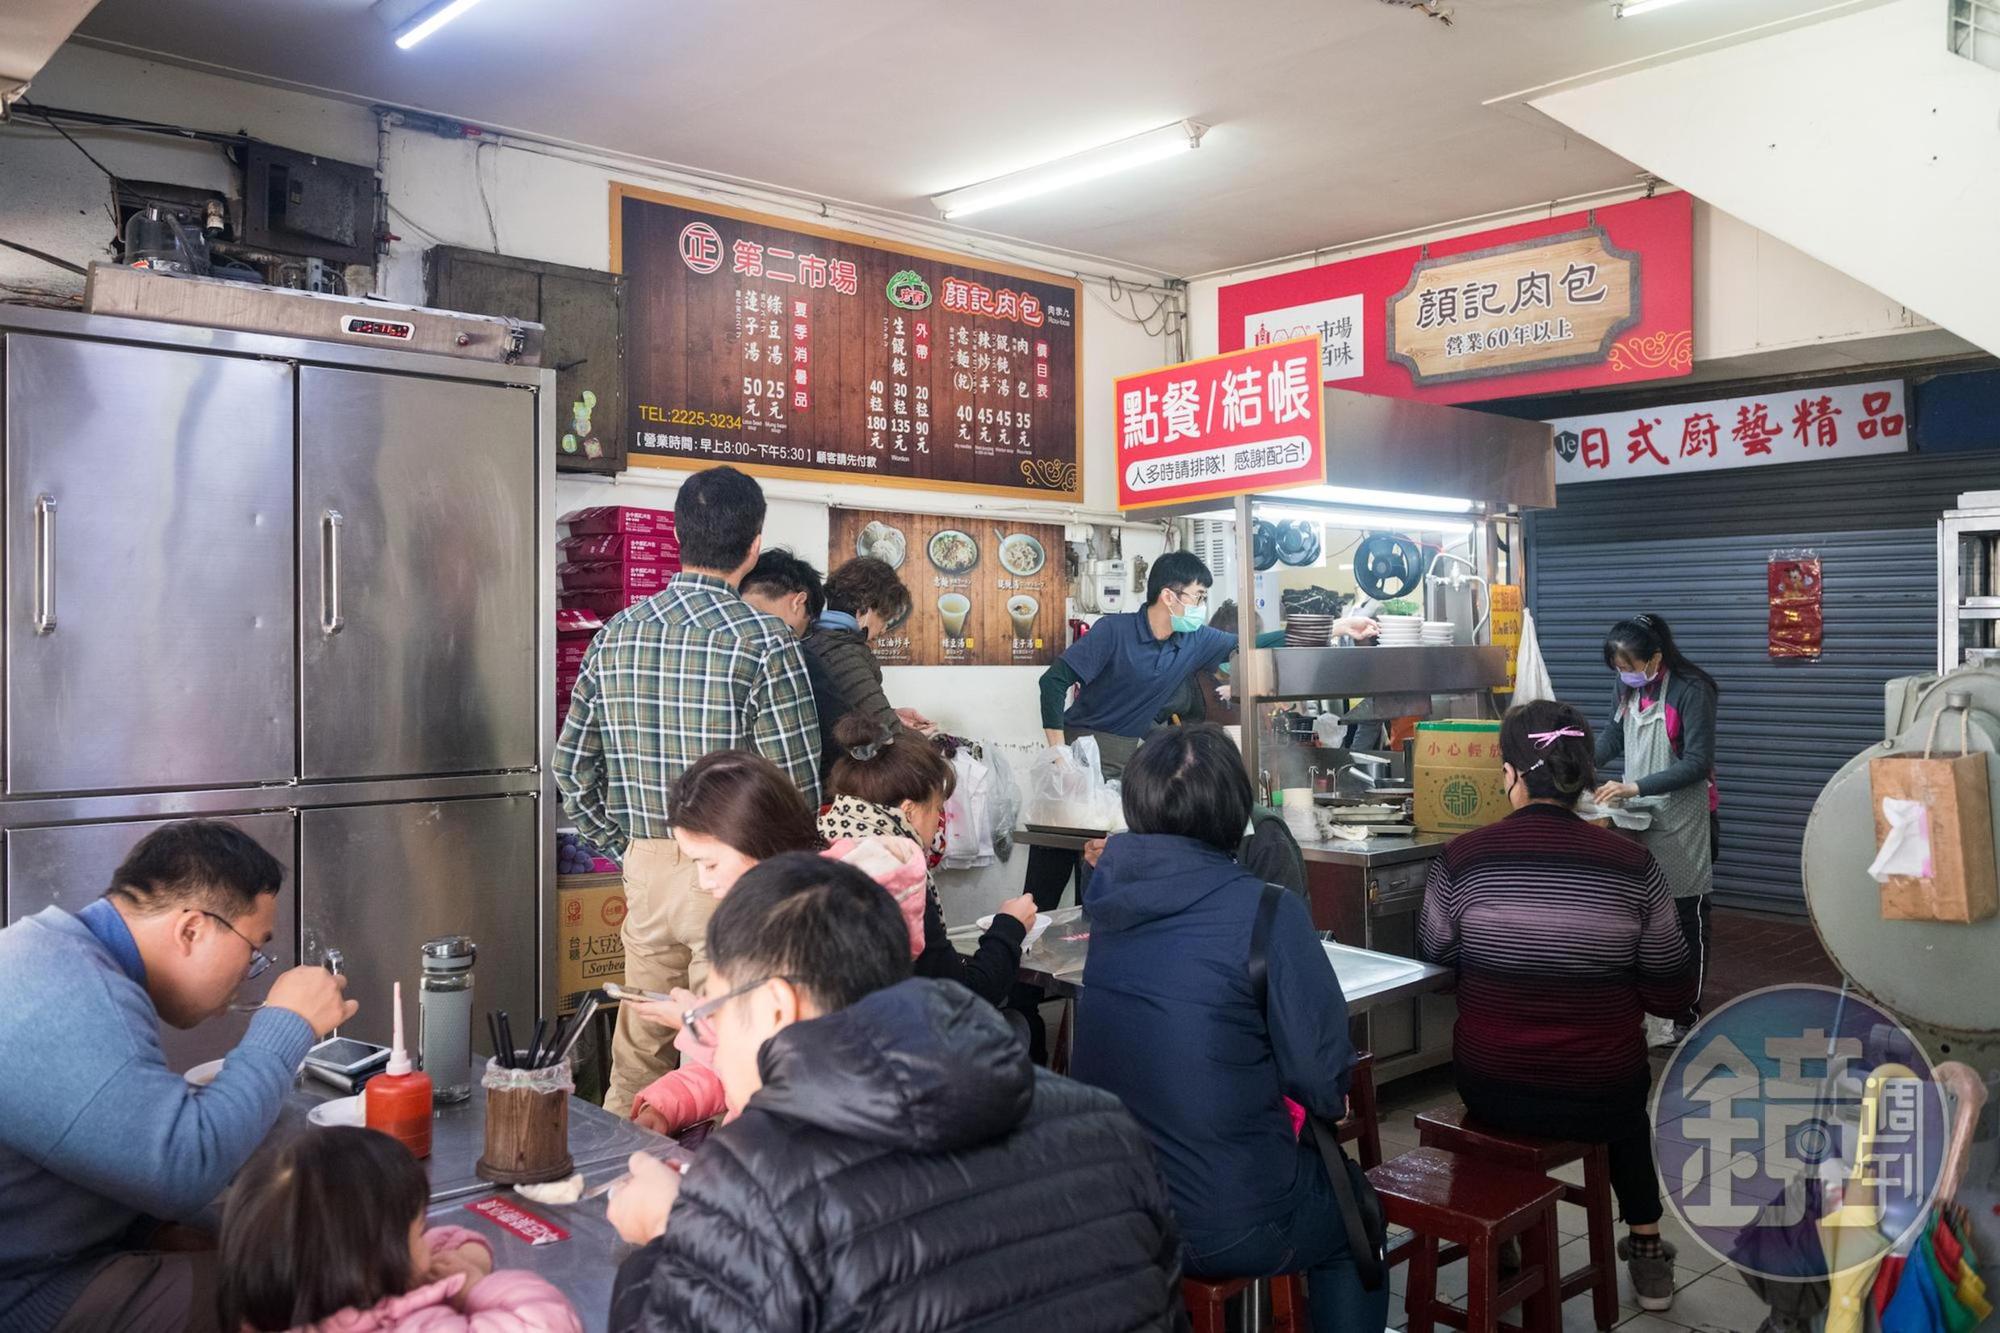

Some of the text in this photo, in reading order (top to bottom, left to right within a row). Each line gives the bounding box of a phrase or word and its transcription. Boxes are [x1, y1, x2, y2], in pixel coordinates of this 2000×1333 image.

[732, 239, 858, 295] 第二市場
[942, 279, 1043, 326] 顏記肉包
[1415, 263, 1607, 329] 顏記肉包
[744, 289, 760, 363] 蓮子湯
[915, 322, 930, 360] 外帶
[1316, 316, 1352, 343] 市場
[1446, 318, 1572, 356] 營業60年以上
[793, 301, 809, 408] 夏季消暑品
[1017, 337, 1030, 398] 肉包
[1036, 343, 1048, 399] 價目表
[1322, 341, 1354, 368] 百味
[638, 404, 742, 431] TEL:2225-3234
[1123, 357, 1311, 450] 點餐/結帳
[1580, 391, 1904, 470] 日式廚藝精品
[1234, 441, 1306, 472] 感謝配合!
